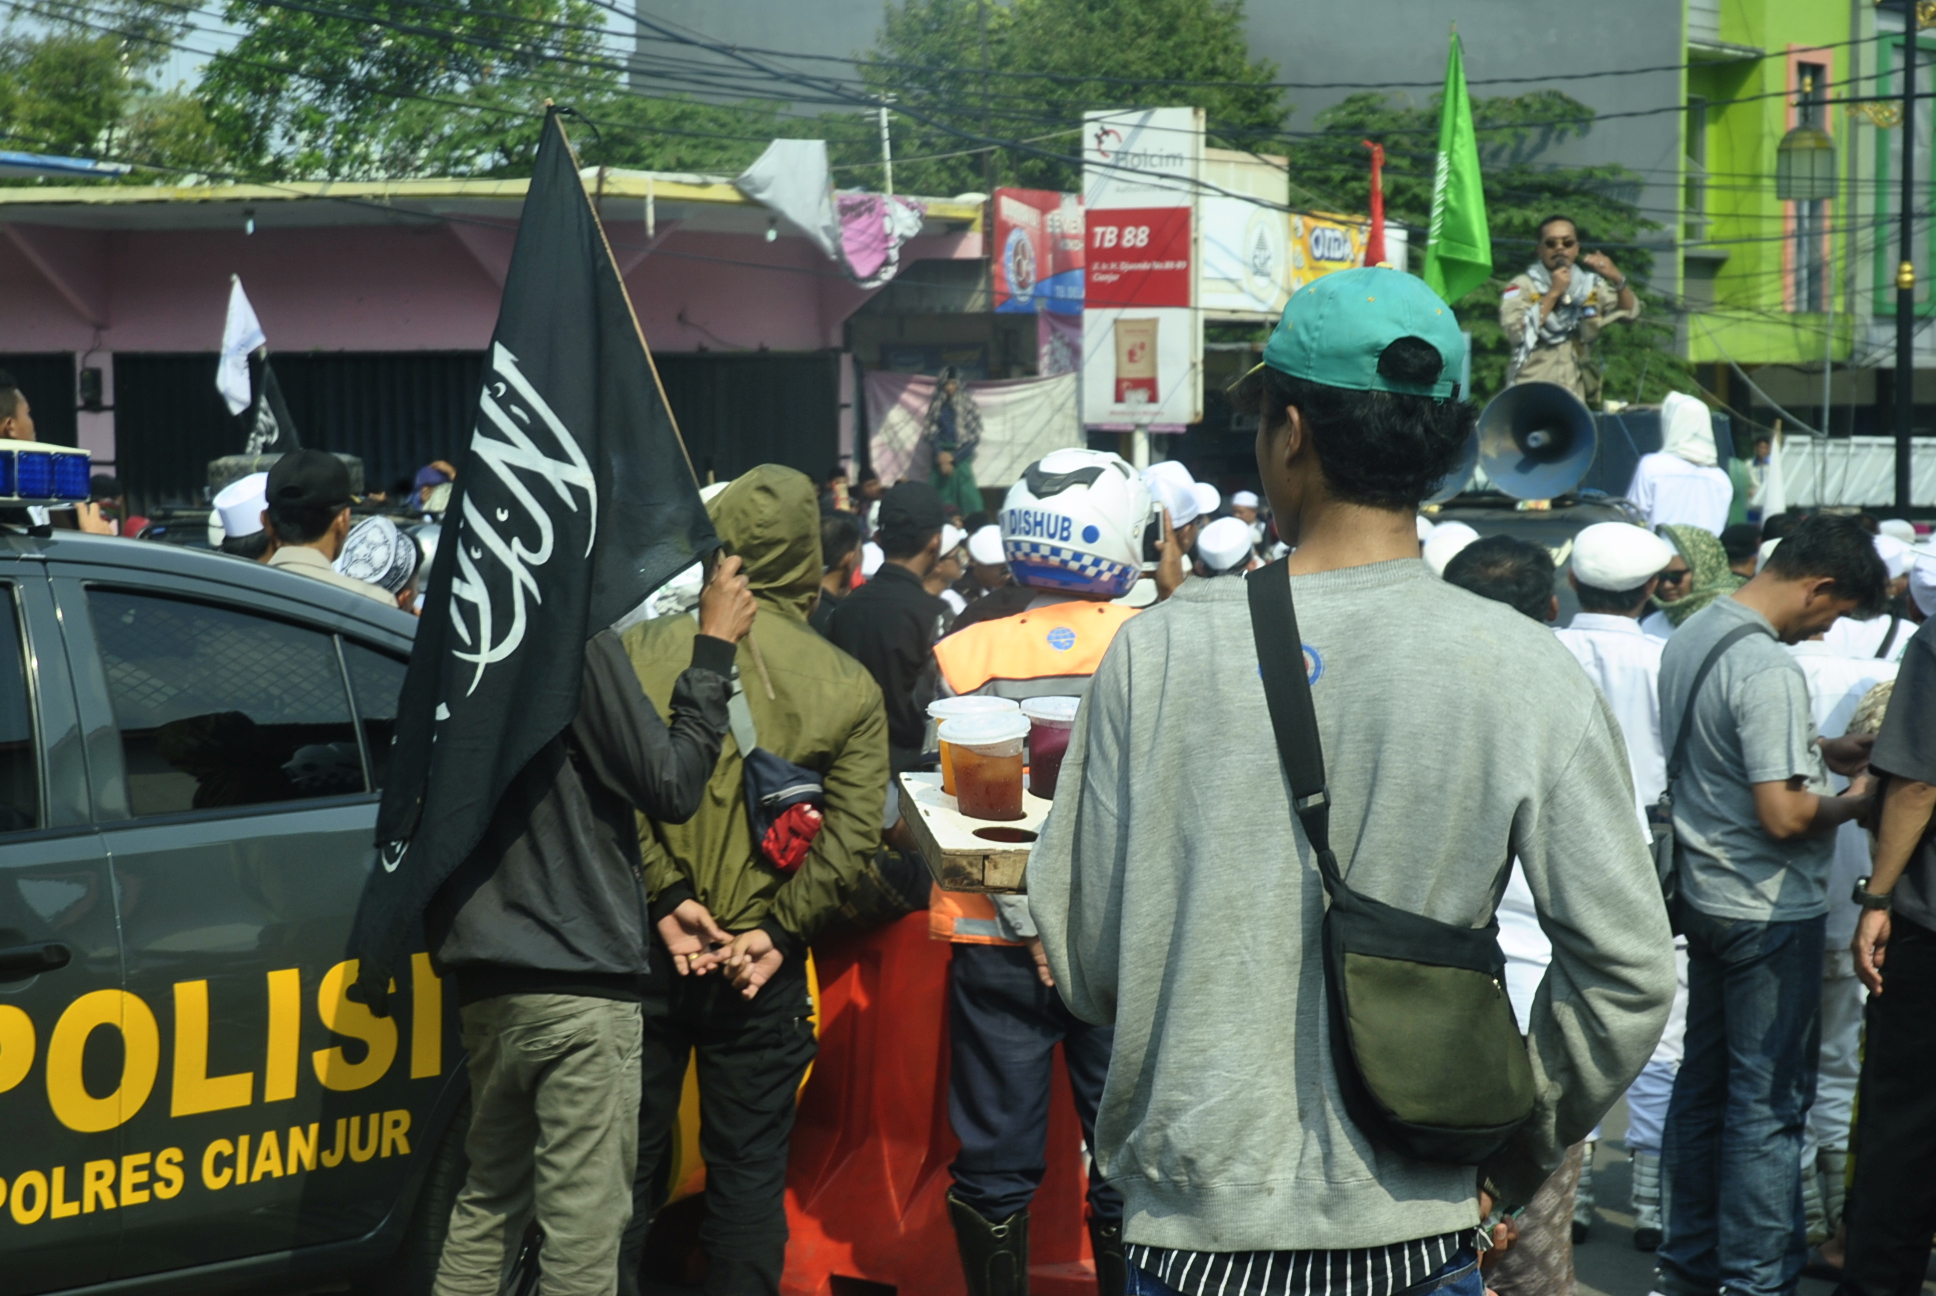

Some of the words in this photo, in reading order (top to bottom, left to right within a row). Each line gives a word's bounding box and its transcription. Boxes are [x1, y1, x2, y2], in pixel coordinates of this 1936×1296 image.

[1116, 147, 1184, 169] Holcim
[1092, 225, 1119, 249] TB
[1121, 225, 1151, 249] 88
[1009, 508, 1072, 542] DISHUB
[0, 1147, 185, 1225] OLRES
[202, 1109, 412, 1190] CIANJUR
